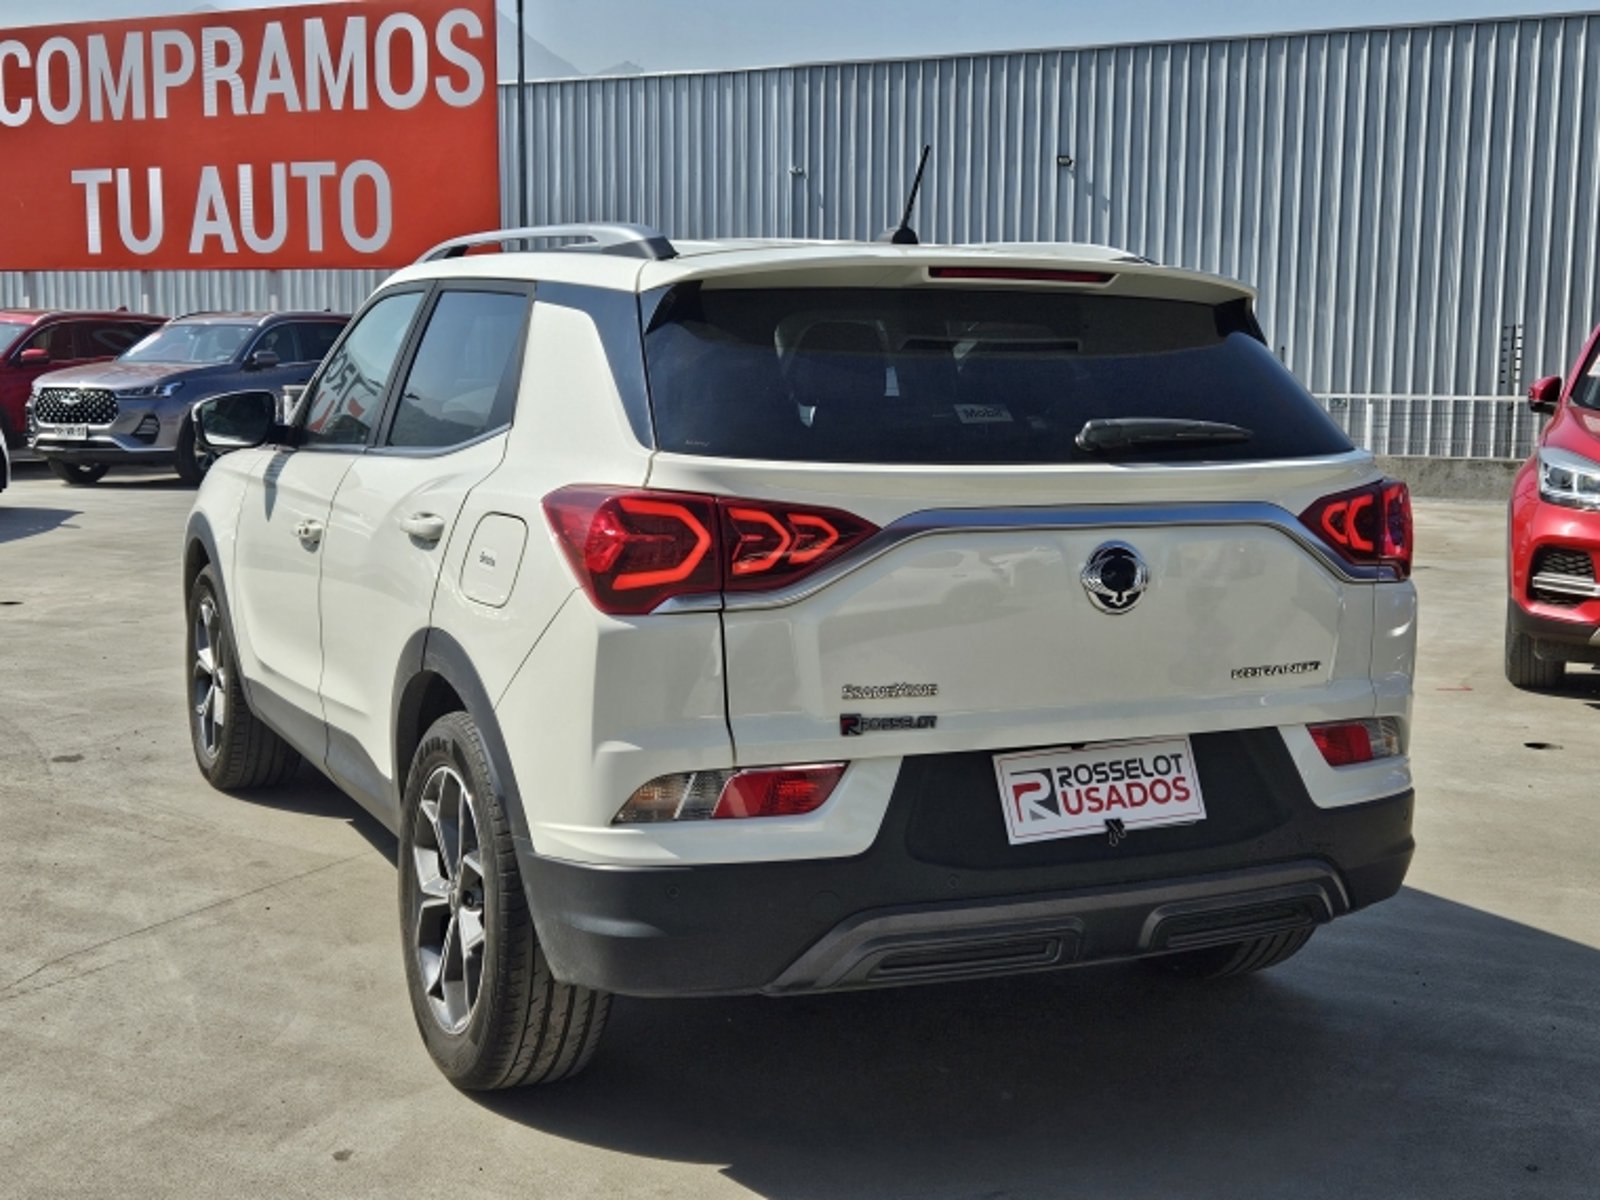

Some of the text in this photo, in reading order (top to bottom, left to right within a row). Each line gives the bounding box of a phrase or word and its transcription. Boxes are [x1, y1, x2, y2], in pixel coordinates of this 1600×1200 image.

[0, 8, 485, 127] COMPRAMOS
[71, 160, 393, 255] TU AUTO
[1056, 753, 1183, 789] ROSSELOT
[1060, 776, 1191, 816] USADOS
